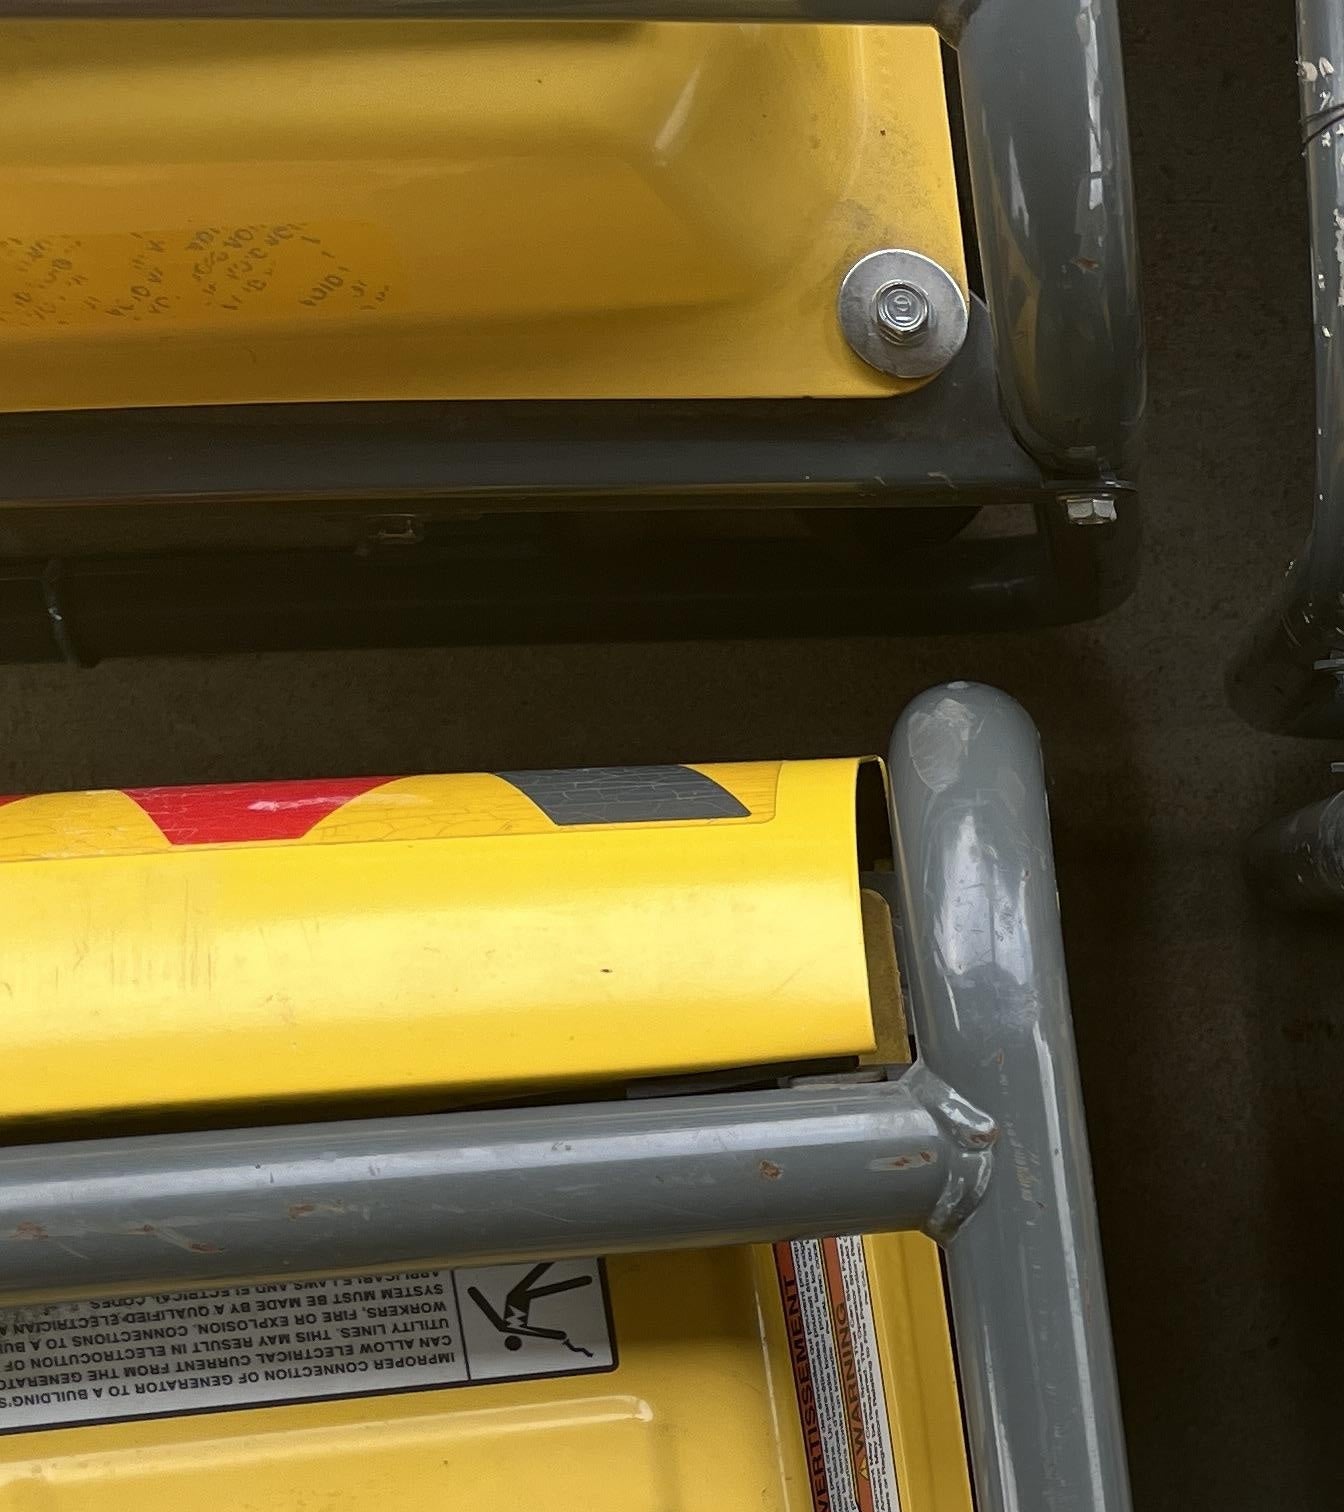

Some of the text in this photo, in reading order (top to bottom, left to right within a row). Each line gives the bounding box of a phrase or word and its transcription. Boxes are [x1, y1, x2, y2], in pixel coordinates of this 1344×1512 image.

[239, 1353, 454, 1383] IMPROPER CONNECTION OF
[836, 1302, 867, 1454] WARNING
